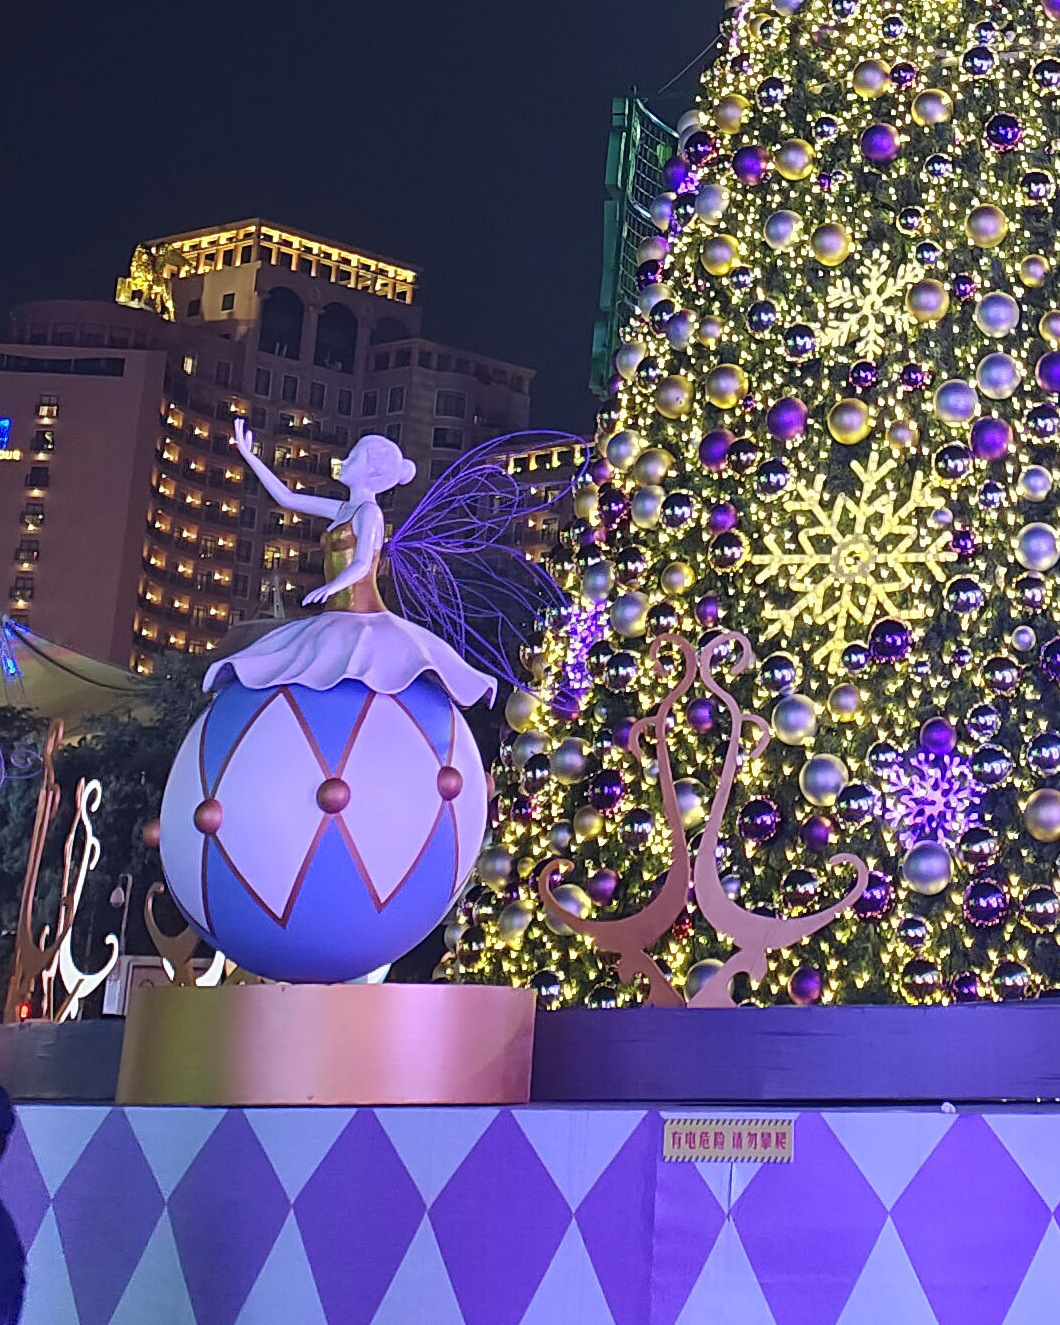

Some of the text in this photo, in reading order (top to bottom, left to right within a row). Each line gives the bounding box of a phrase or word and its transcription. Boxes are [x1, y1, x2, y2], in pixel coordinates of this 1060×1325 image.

[672, 1130, 787, 1150] 有电危险 请勿攀爬
